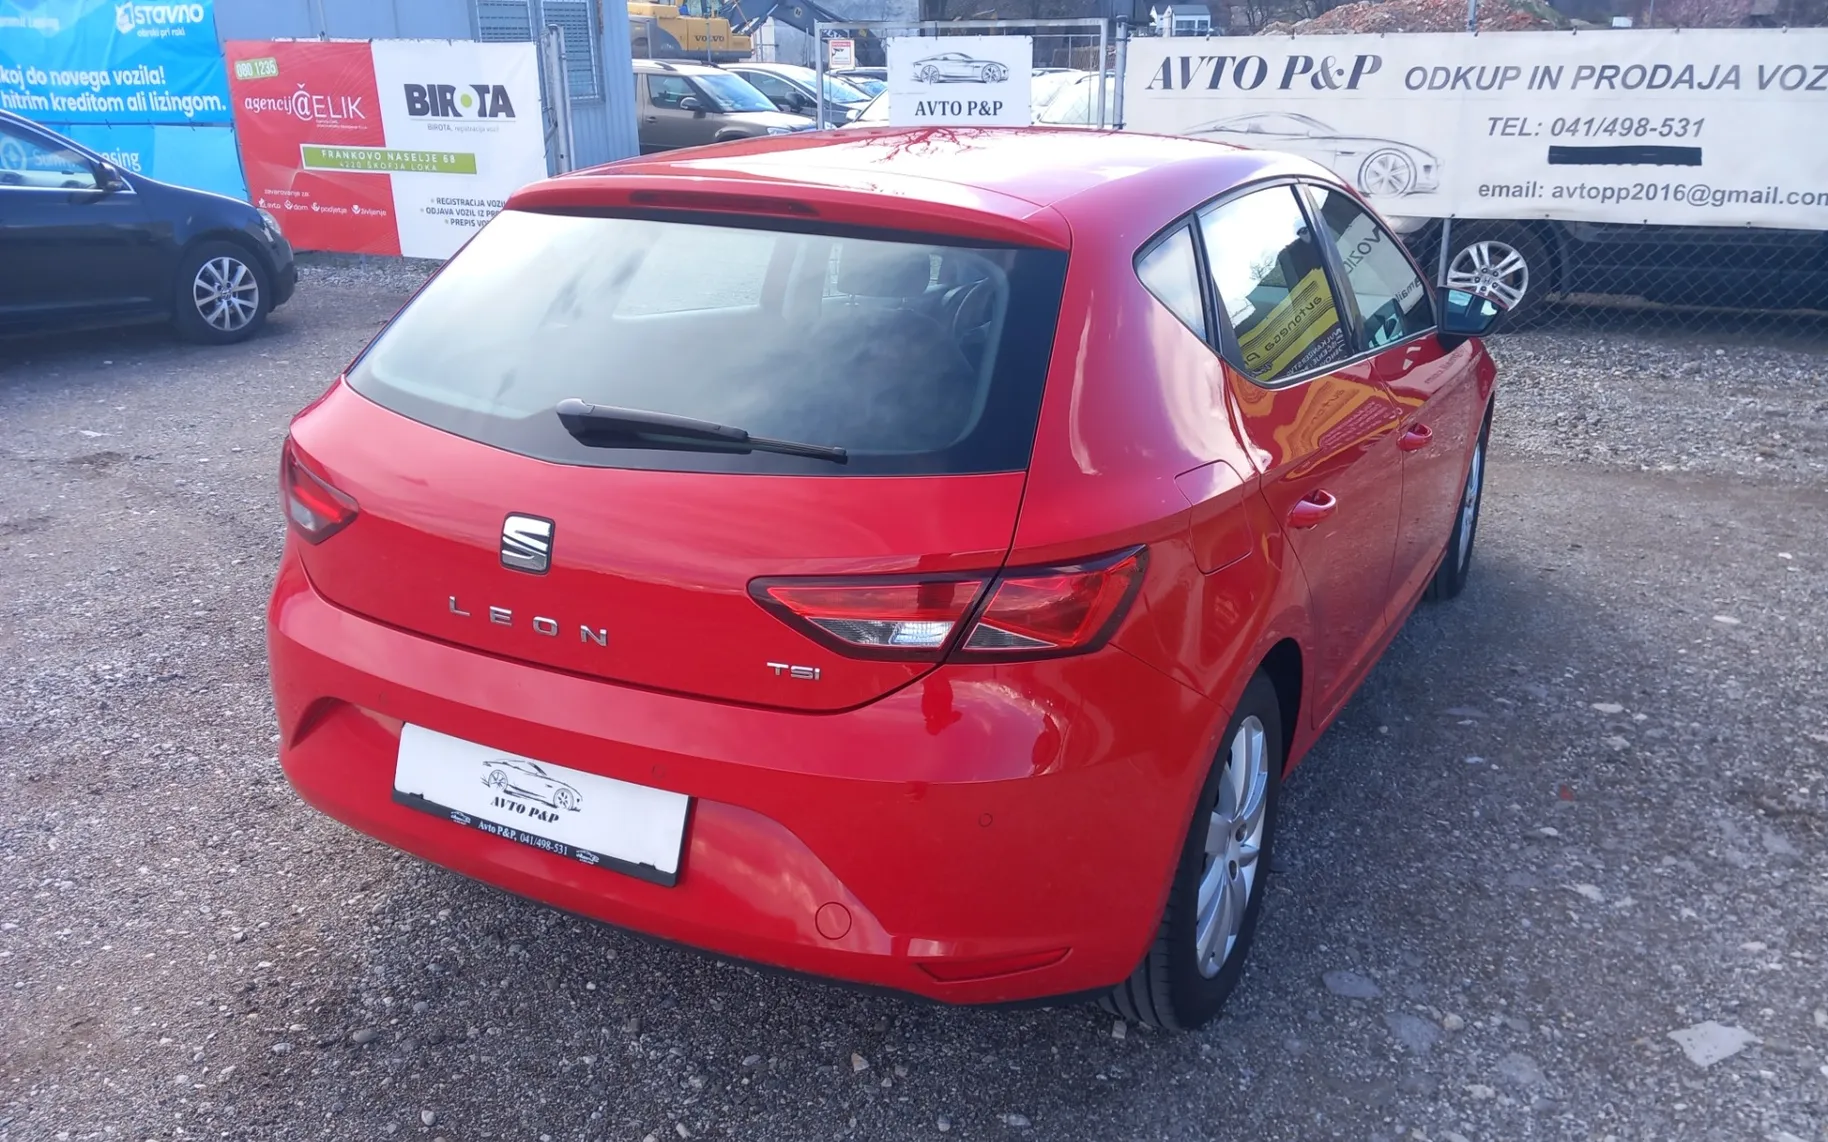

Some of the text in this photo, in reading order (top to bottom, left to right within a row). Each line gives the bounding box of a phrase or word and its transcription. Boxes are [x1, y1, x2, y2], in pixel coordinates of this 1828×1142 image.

[26, 65, 48, 86] do
[49, 70, 109, 92] novega
[112, 65, 166, 86] vozila!
[236, 62, 253, 78] 080
[1144, 54, 1383, 91] AVTO P&P
[1404, 64, 1828, 91] ODKUP IN PRODAJA VOZ
[0, 89, 227, 118] hitrim kreditom ali lizingom.
[914, 100, 1004, 116] AVTO P&P
[1487, 116, 1706, 138] TEL: 041/498-531
[321, 149, 383, 161] FRANKOVO
[387, 151, 438, 163] NASELJE
[410, 163, 438, 172] LOKA
[1477, 181, 1544, 199] email:
[293, 203, 309, 211] dom
[425, 206, 454, 216] ODJAVA
[455, 208, 476, 217] VOZIL
[477, 209, 485, 217] IZ
[436, 197, 485, 208] REGISTRACIJA
[450, 218, 476, 227] PREPIS
[448, 595, 609, 647] LEON
[490, 796, 560, 823] AVTO P&P
[478, 819, 497, 834] Avto
[519, 832, 568, 856] 041/498-531
